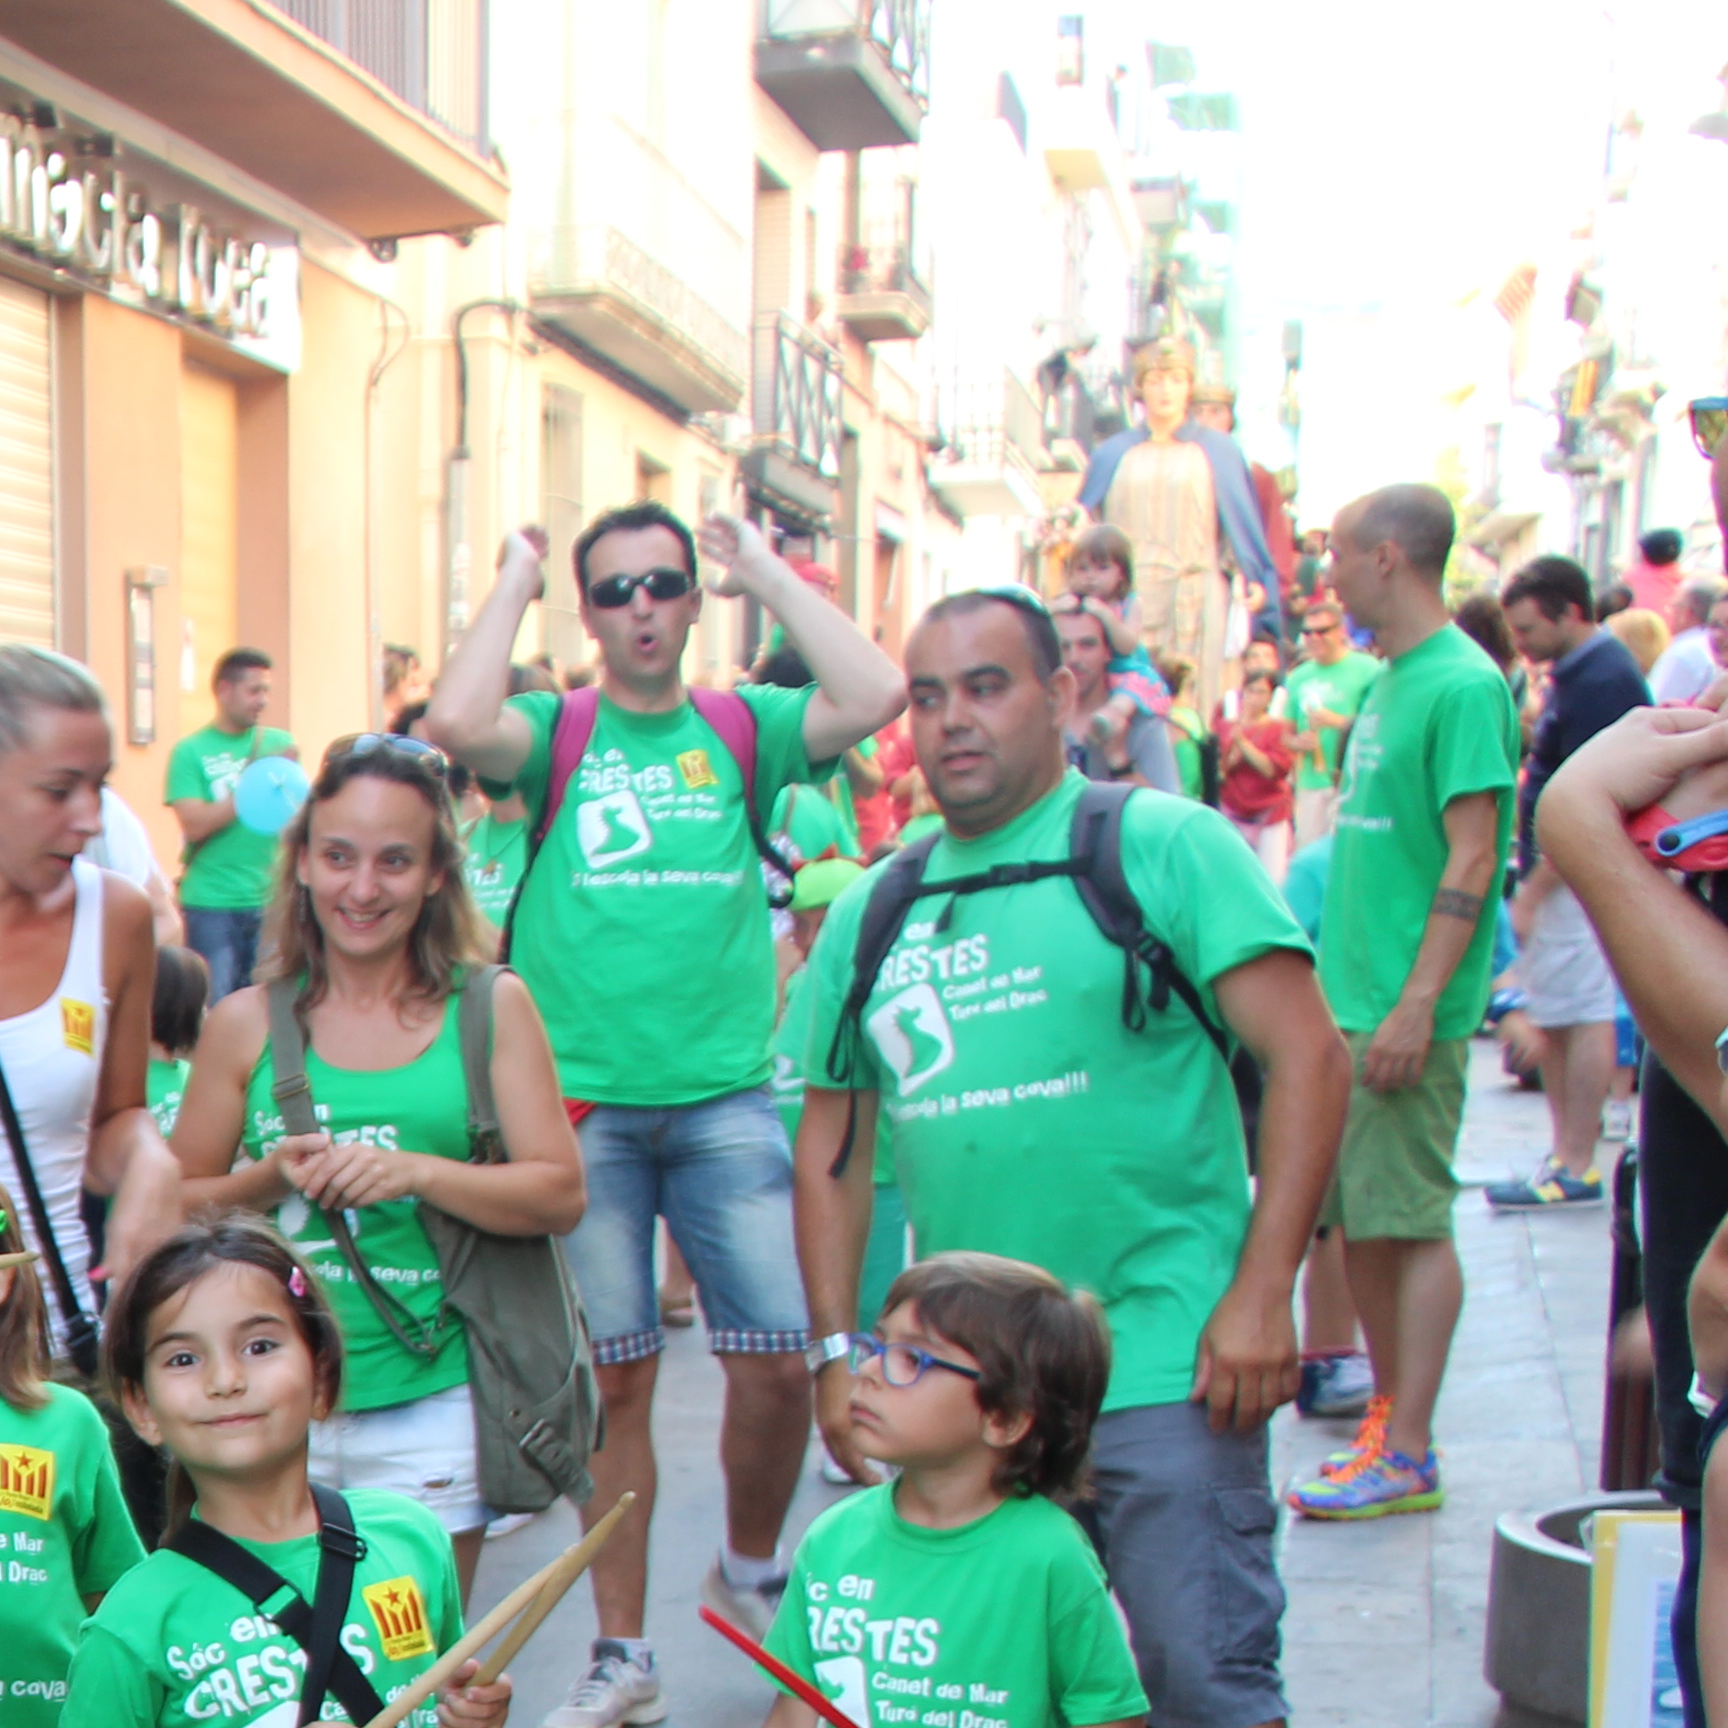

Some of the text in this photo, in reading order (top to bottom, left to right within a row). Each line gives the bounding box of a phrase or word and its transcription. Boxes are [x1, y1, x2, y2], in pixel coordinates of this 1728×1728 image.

[877, 934, 990, 991] RESTES
[13, 1532, 44, 1556] Mar
[8, 1559, 48, 1585] Drac
[837, 1574, 876, 1601] en
[807, 1605, 941, 1668] RESTES
[166, 1642, 226, 1680] Sóc
[871, 1672, 1009, 1705] Canet de Mar
[875, 1699, 919, 1722] Turó
